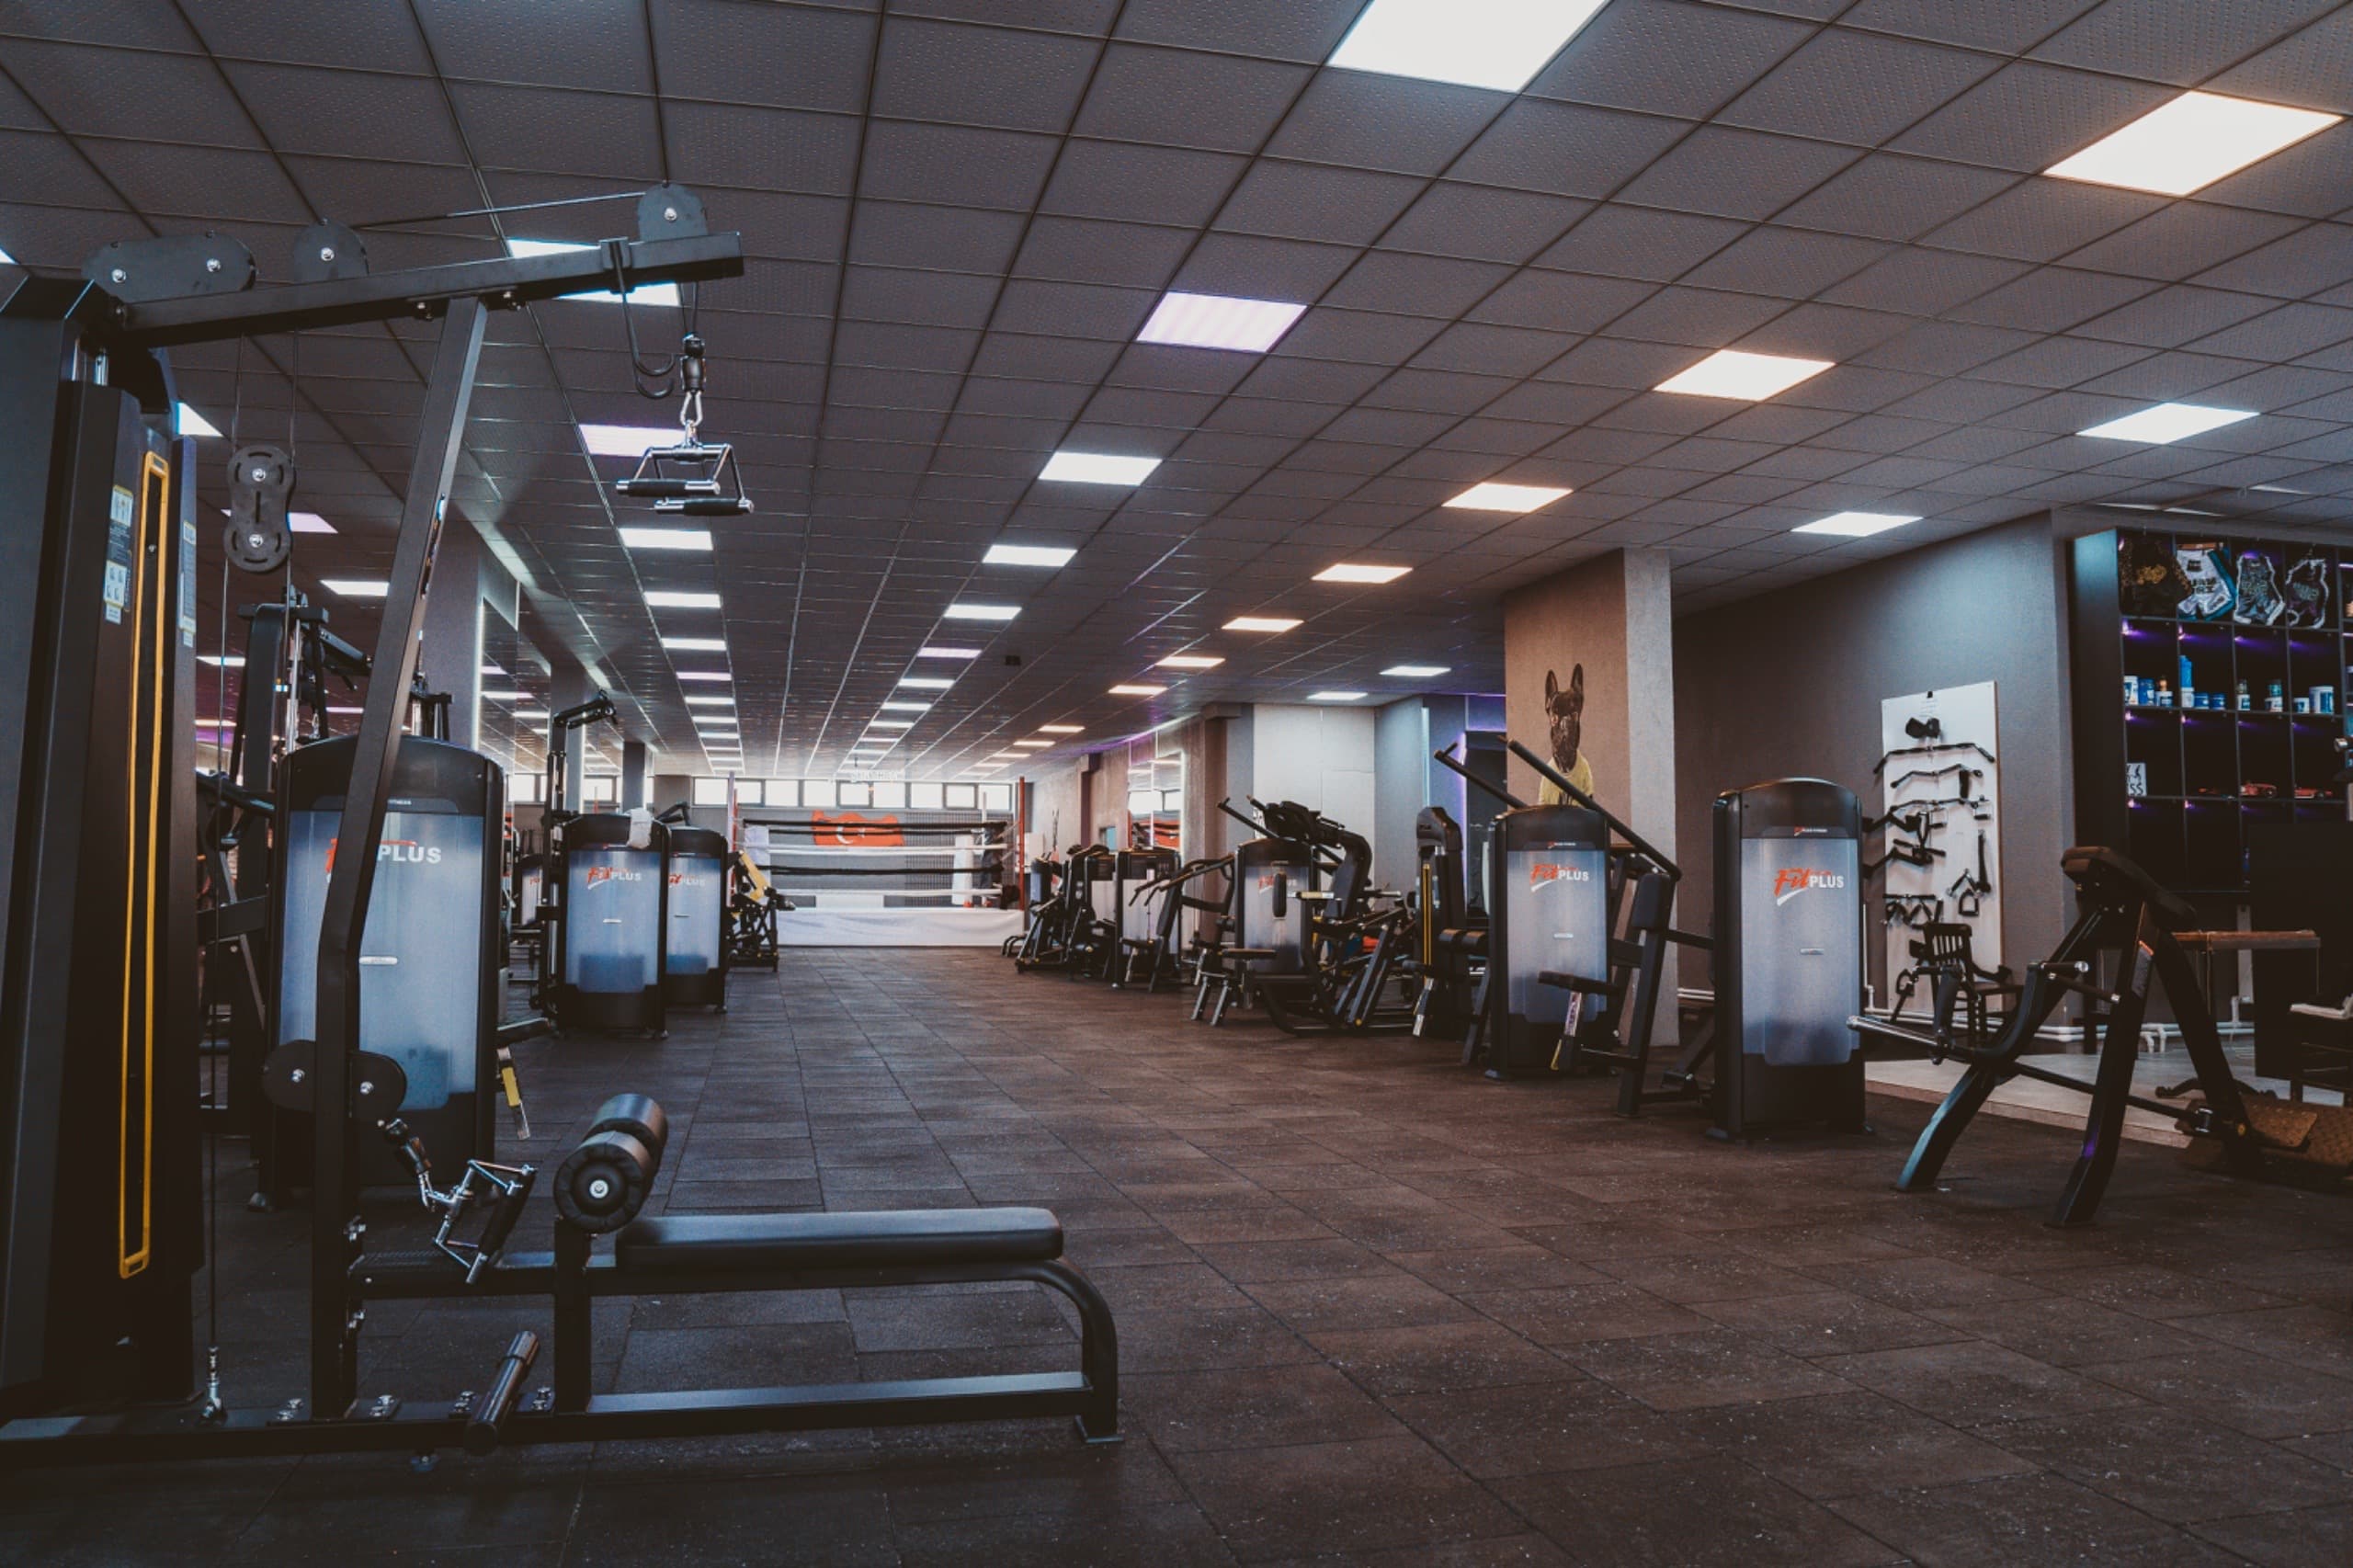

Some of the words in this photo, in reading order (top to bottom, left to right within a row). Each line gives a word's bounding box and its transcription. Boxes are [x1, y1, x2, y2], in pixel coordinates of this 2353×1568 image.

[377, 845, 442, 864] PLUS
[611, 870, 642, 881] PLUS
[1558, 869, 1589, 881] PLUS
[1808, 874, 1845, 889] PLUS
